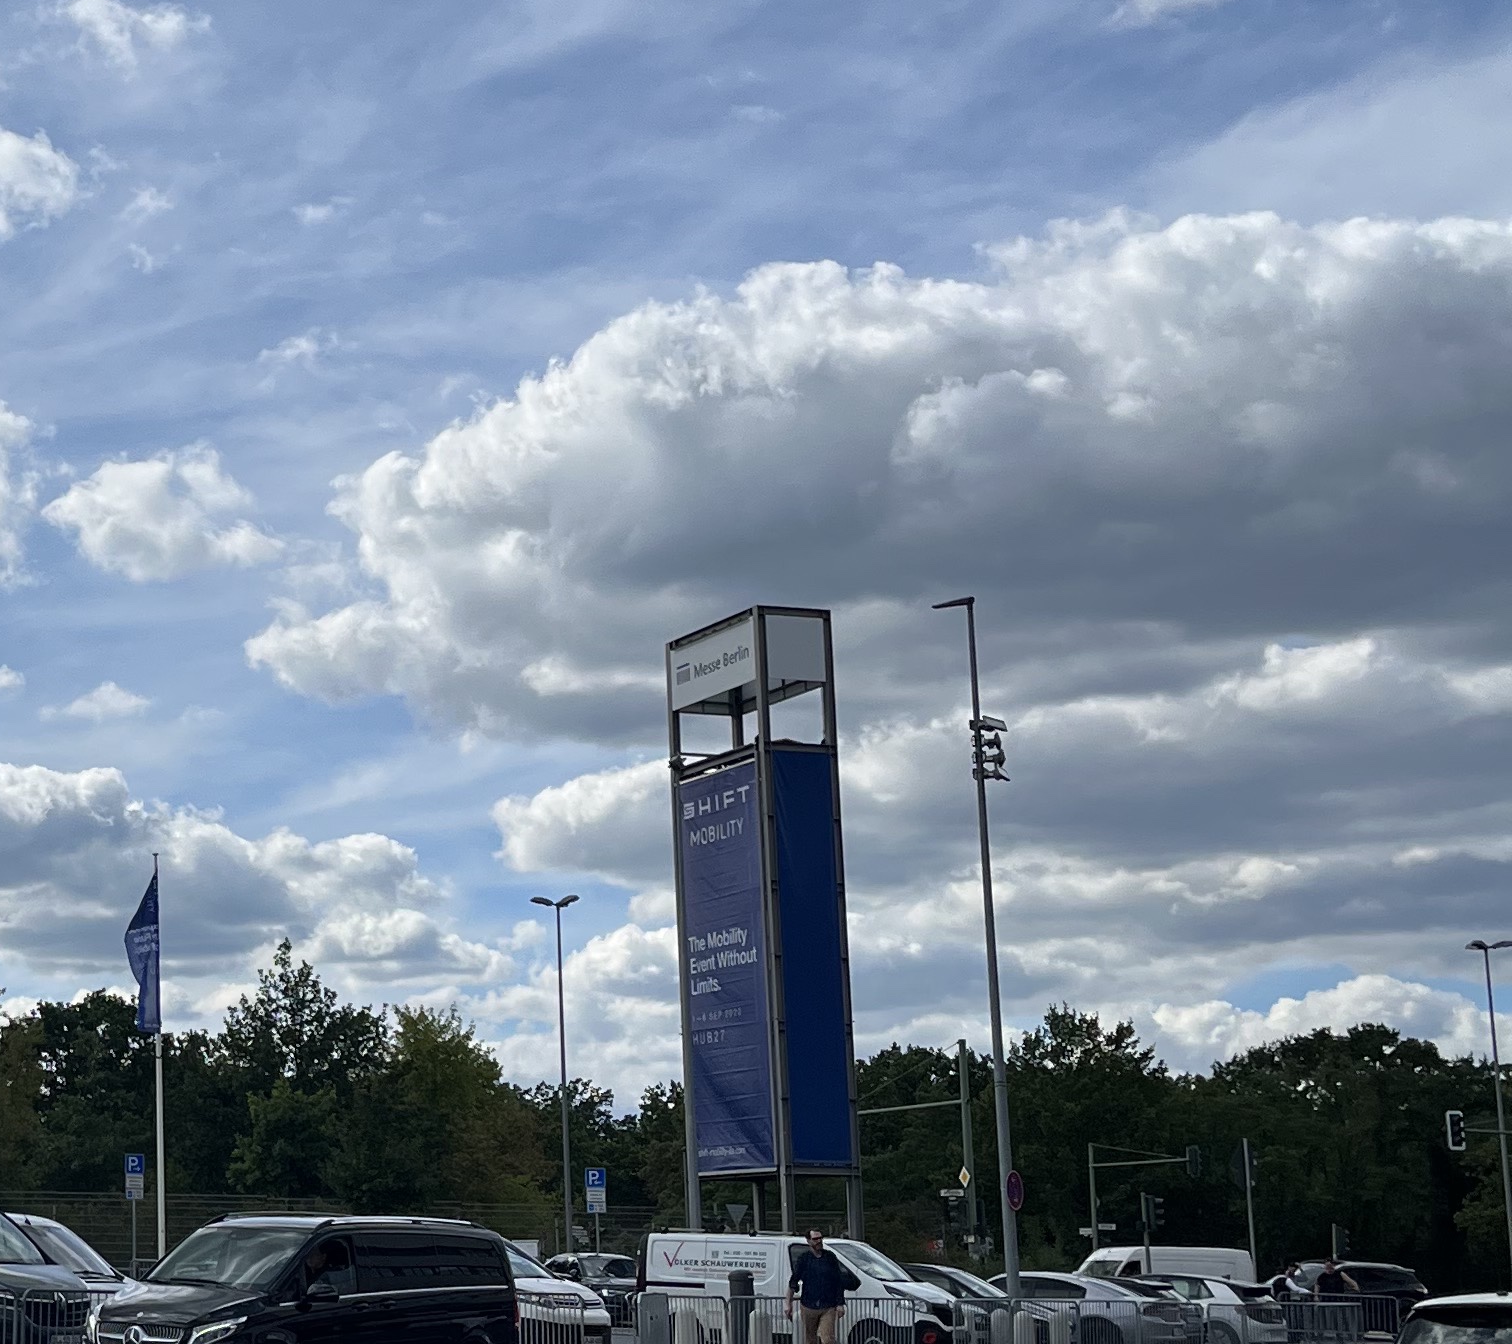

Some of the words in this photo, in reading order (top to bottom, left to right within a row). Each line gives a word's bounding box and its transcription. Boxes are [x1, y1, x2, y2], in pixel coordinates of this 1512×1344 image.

[694, 659, 721, 678] Messe
[723, 645, 750, 667] Berlin
[683, 785, 750, 820] SHIFT
[690, 817, 744, 847] MOBILITY
[688, 936, 706, 953] The
[707, 927, 748, 949] Mobility
[690, 955, 716, 974] Event
[717, 946, 758, 969] Without
[691, 976, 722, 996] Limits.
[692, 1029, 726, 1045] HUB27
[128, 1156, 139, 1171] P
[588, 1170, 600, 1185] P
[700, 1258, 767, 1269] SCHAUWERBUNG
